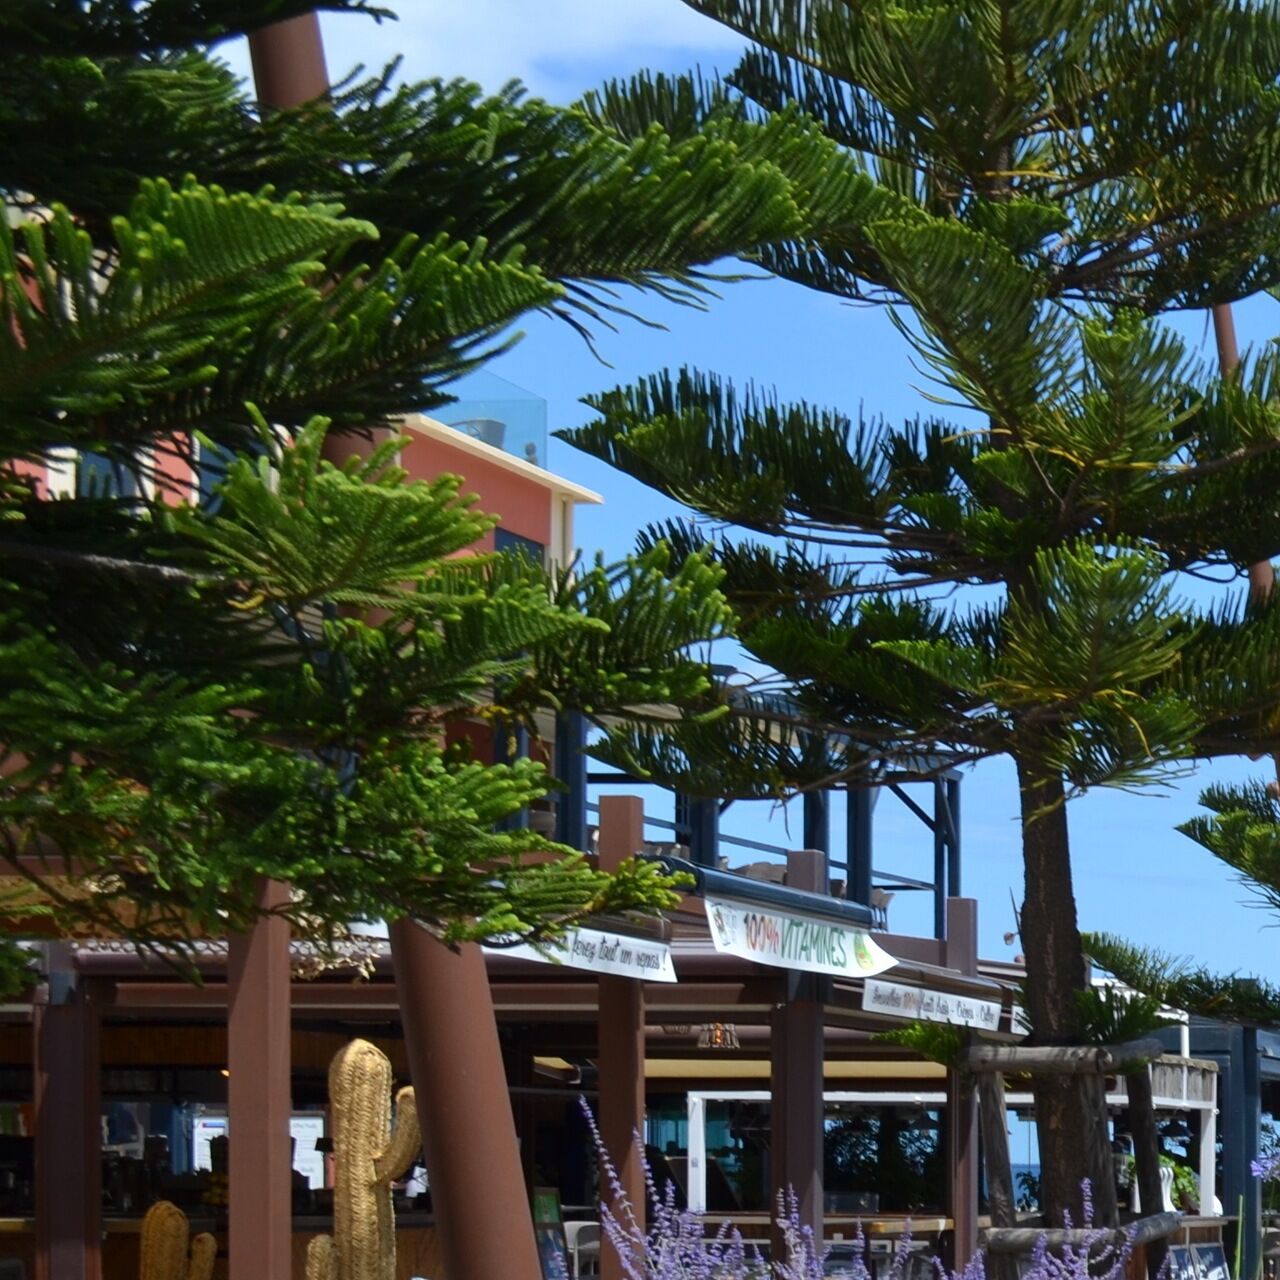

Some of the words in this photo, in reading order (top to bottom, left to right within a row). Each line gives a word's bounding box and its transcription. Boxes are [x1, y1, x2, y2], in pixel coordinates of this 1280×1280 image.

[599, 935, 621, 961] tout
[743, 911, 779, 955] 100%
[780, 918, 848, 969] VITAMINES
